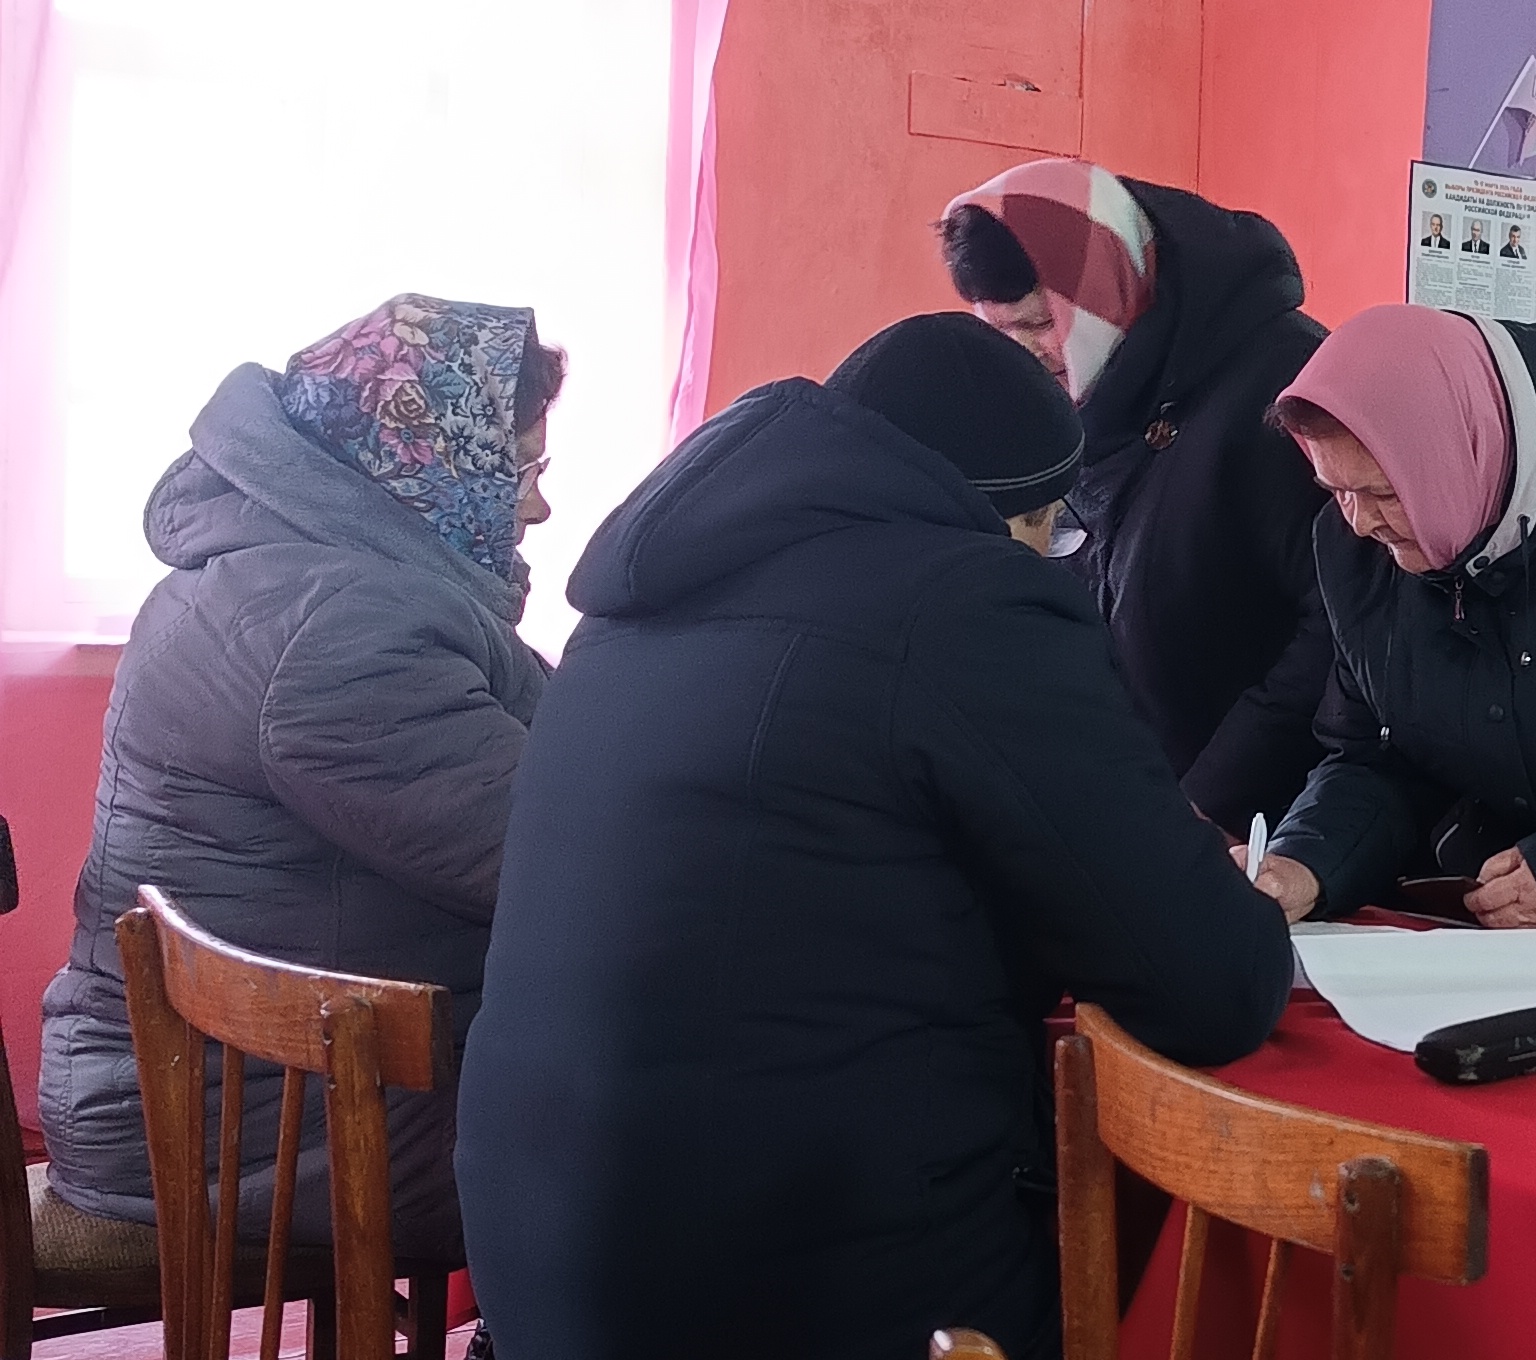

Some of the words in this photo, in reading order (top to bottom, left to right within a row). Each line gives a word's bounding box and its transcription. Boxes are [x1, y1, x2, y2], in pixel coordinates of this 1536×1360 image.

[1445, 193, 1478, 204] КАНДИДАТЫ
[1478, 197, 1485, 205] НА
[1485, 198, 1516, 210] ДОЛЖНОСТЬ
[1464, 204, 1498, 216] РОССИЙСКОЙ
